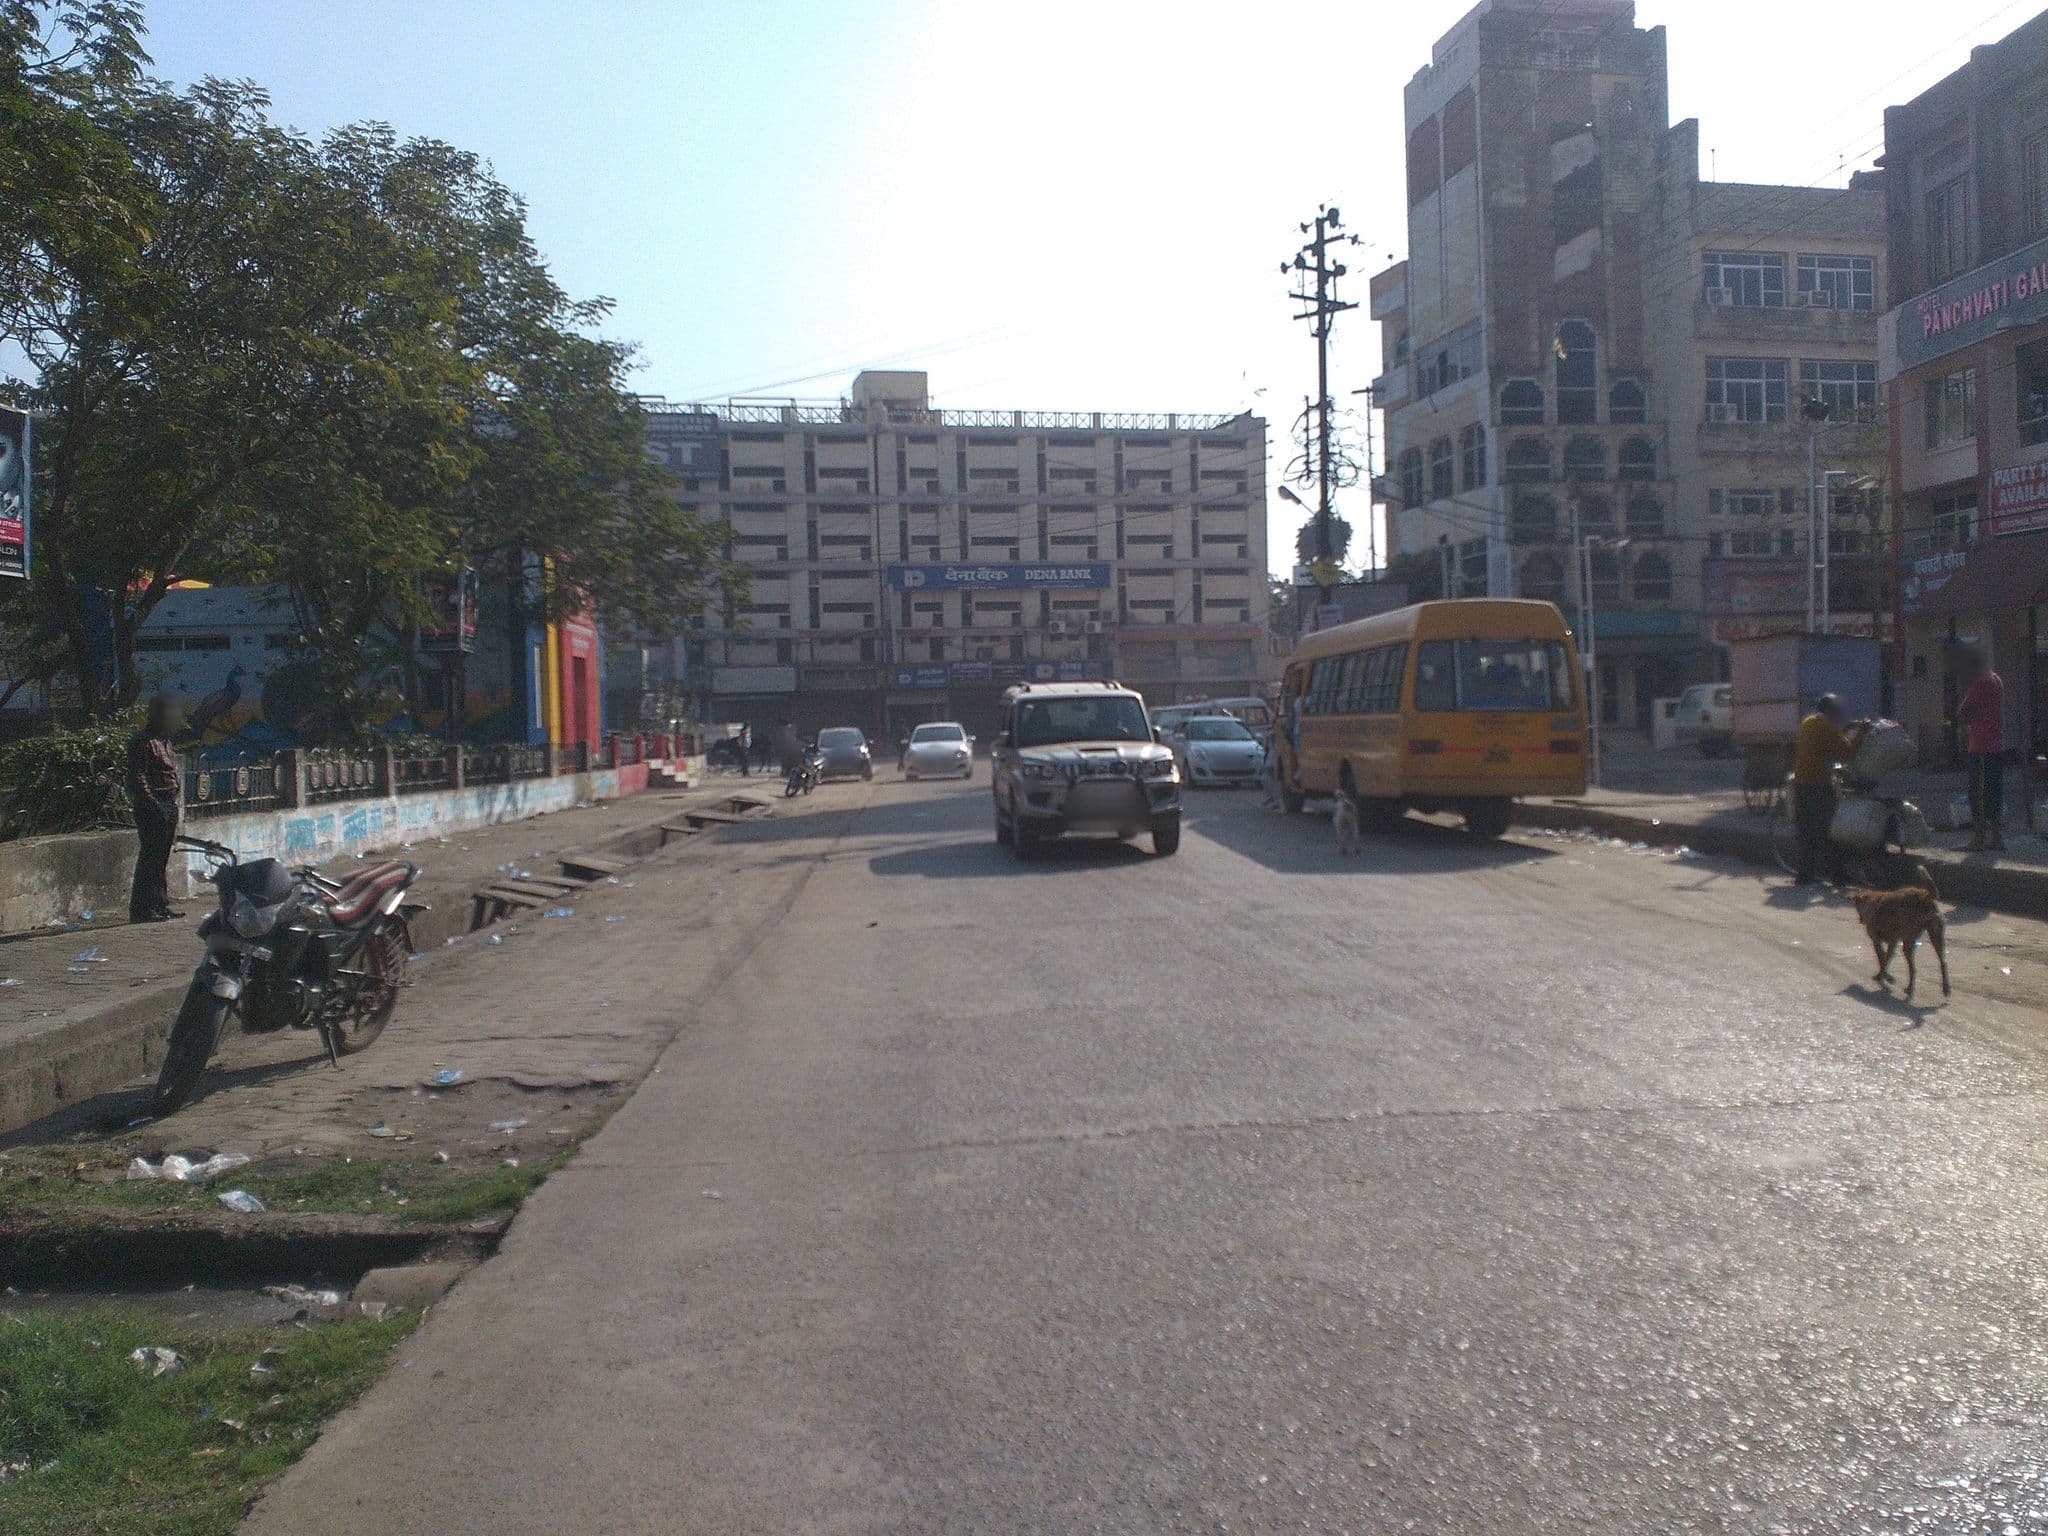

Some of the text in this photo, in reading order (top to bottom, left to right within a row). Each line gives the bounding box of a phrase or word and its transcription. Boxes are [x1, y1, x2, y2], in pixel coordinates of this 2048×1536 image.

[1923, 279, 2009, 337] PANCHVATI
[1993, 465, 2035, 487] PARTY
[1025, 569, 1092, 580] DENA BANK
